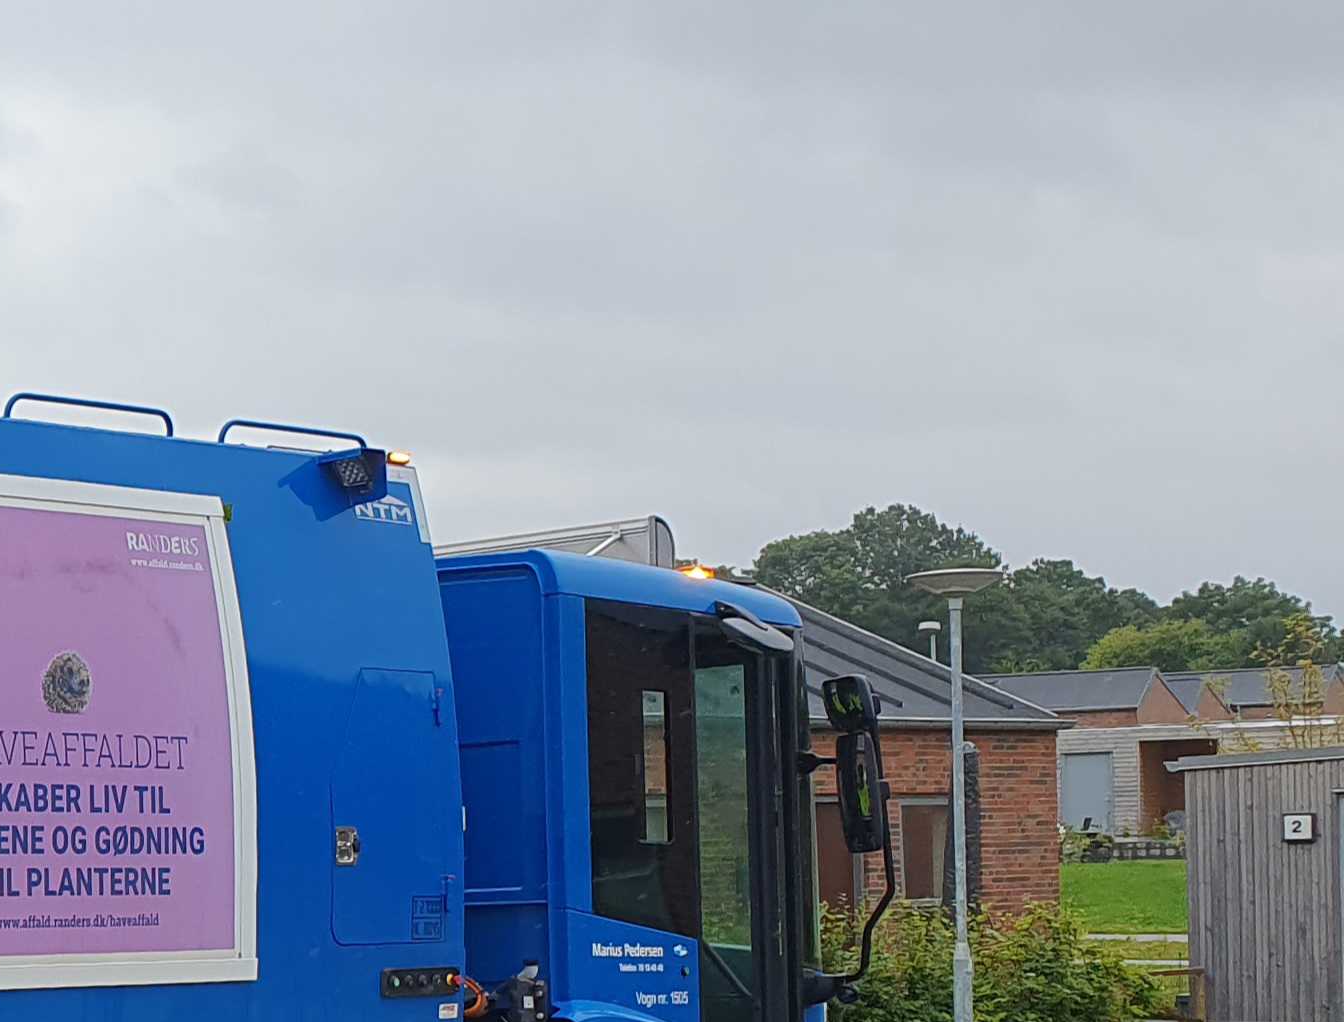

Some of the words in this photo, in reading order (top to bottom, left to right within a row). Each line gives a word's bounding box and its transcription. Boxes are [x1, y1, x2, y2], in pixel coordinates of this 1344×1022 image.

[355, 502, 412, 521] NTM
[126, 531, 199, 556] RANDERS
[89, 784, 128, 814] LIV
[134, 785, 171, 814] TIL
[1292, 820, 1302, 833] 2
[52, 825, 87, 855] OG
[94, 825, 205, 857] GØDNING
[26, 867, 171, 897] PLANTERNE
[592, 942, 623, 958] Marius
[624, 942, 664, 958] Pedersen
[635, 991, 657, 1008] Vogn
[657, 995, 669, 1005] nr.
